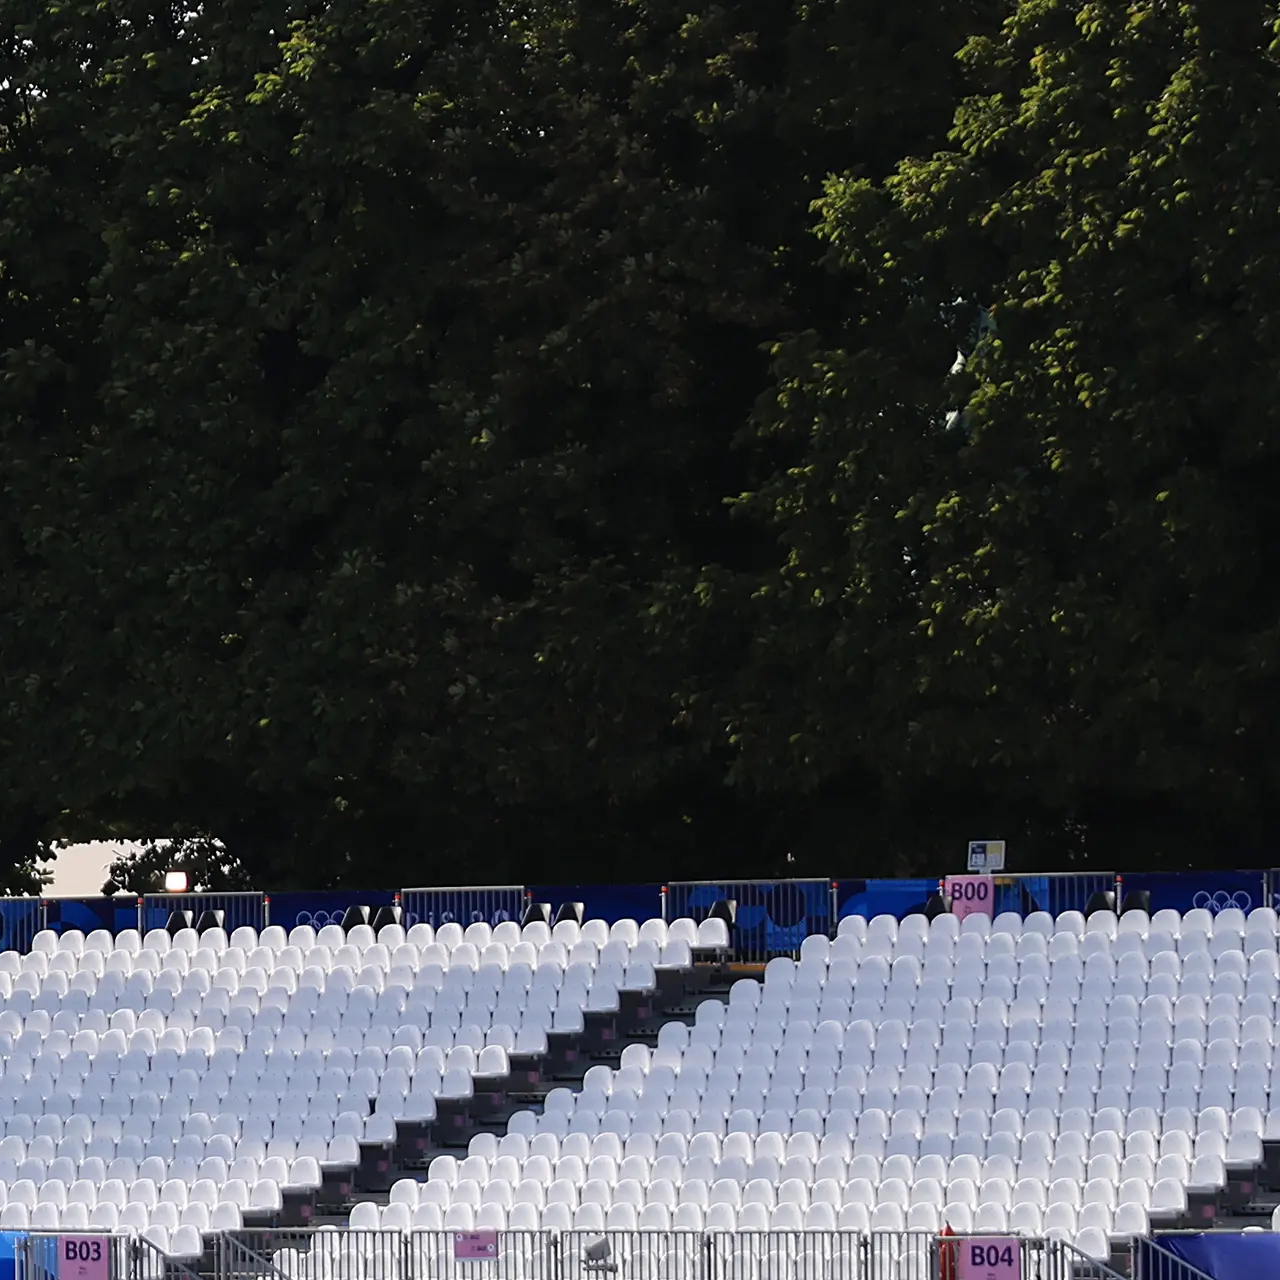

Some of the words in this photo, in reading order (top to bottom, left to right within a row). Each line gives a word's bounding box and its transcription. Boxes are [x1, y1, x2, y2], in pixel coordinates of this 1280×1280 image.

[951, 882, 988, 901] B00
[65, 1240, 102, 1261] B03
[971, 1245, 1014, 1267] B04
